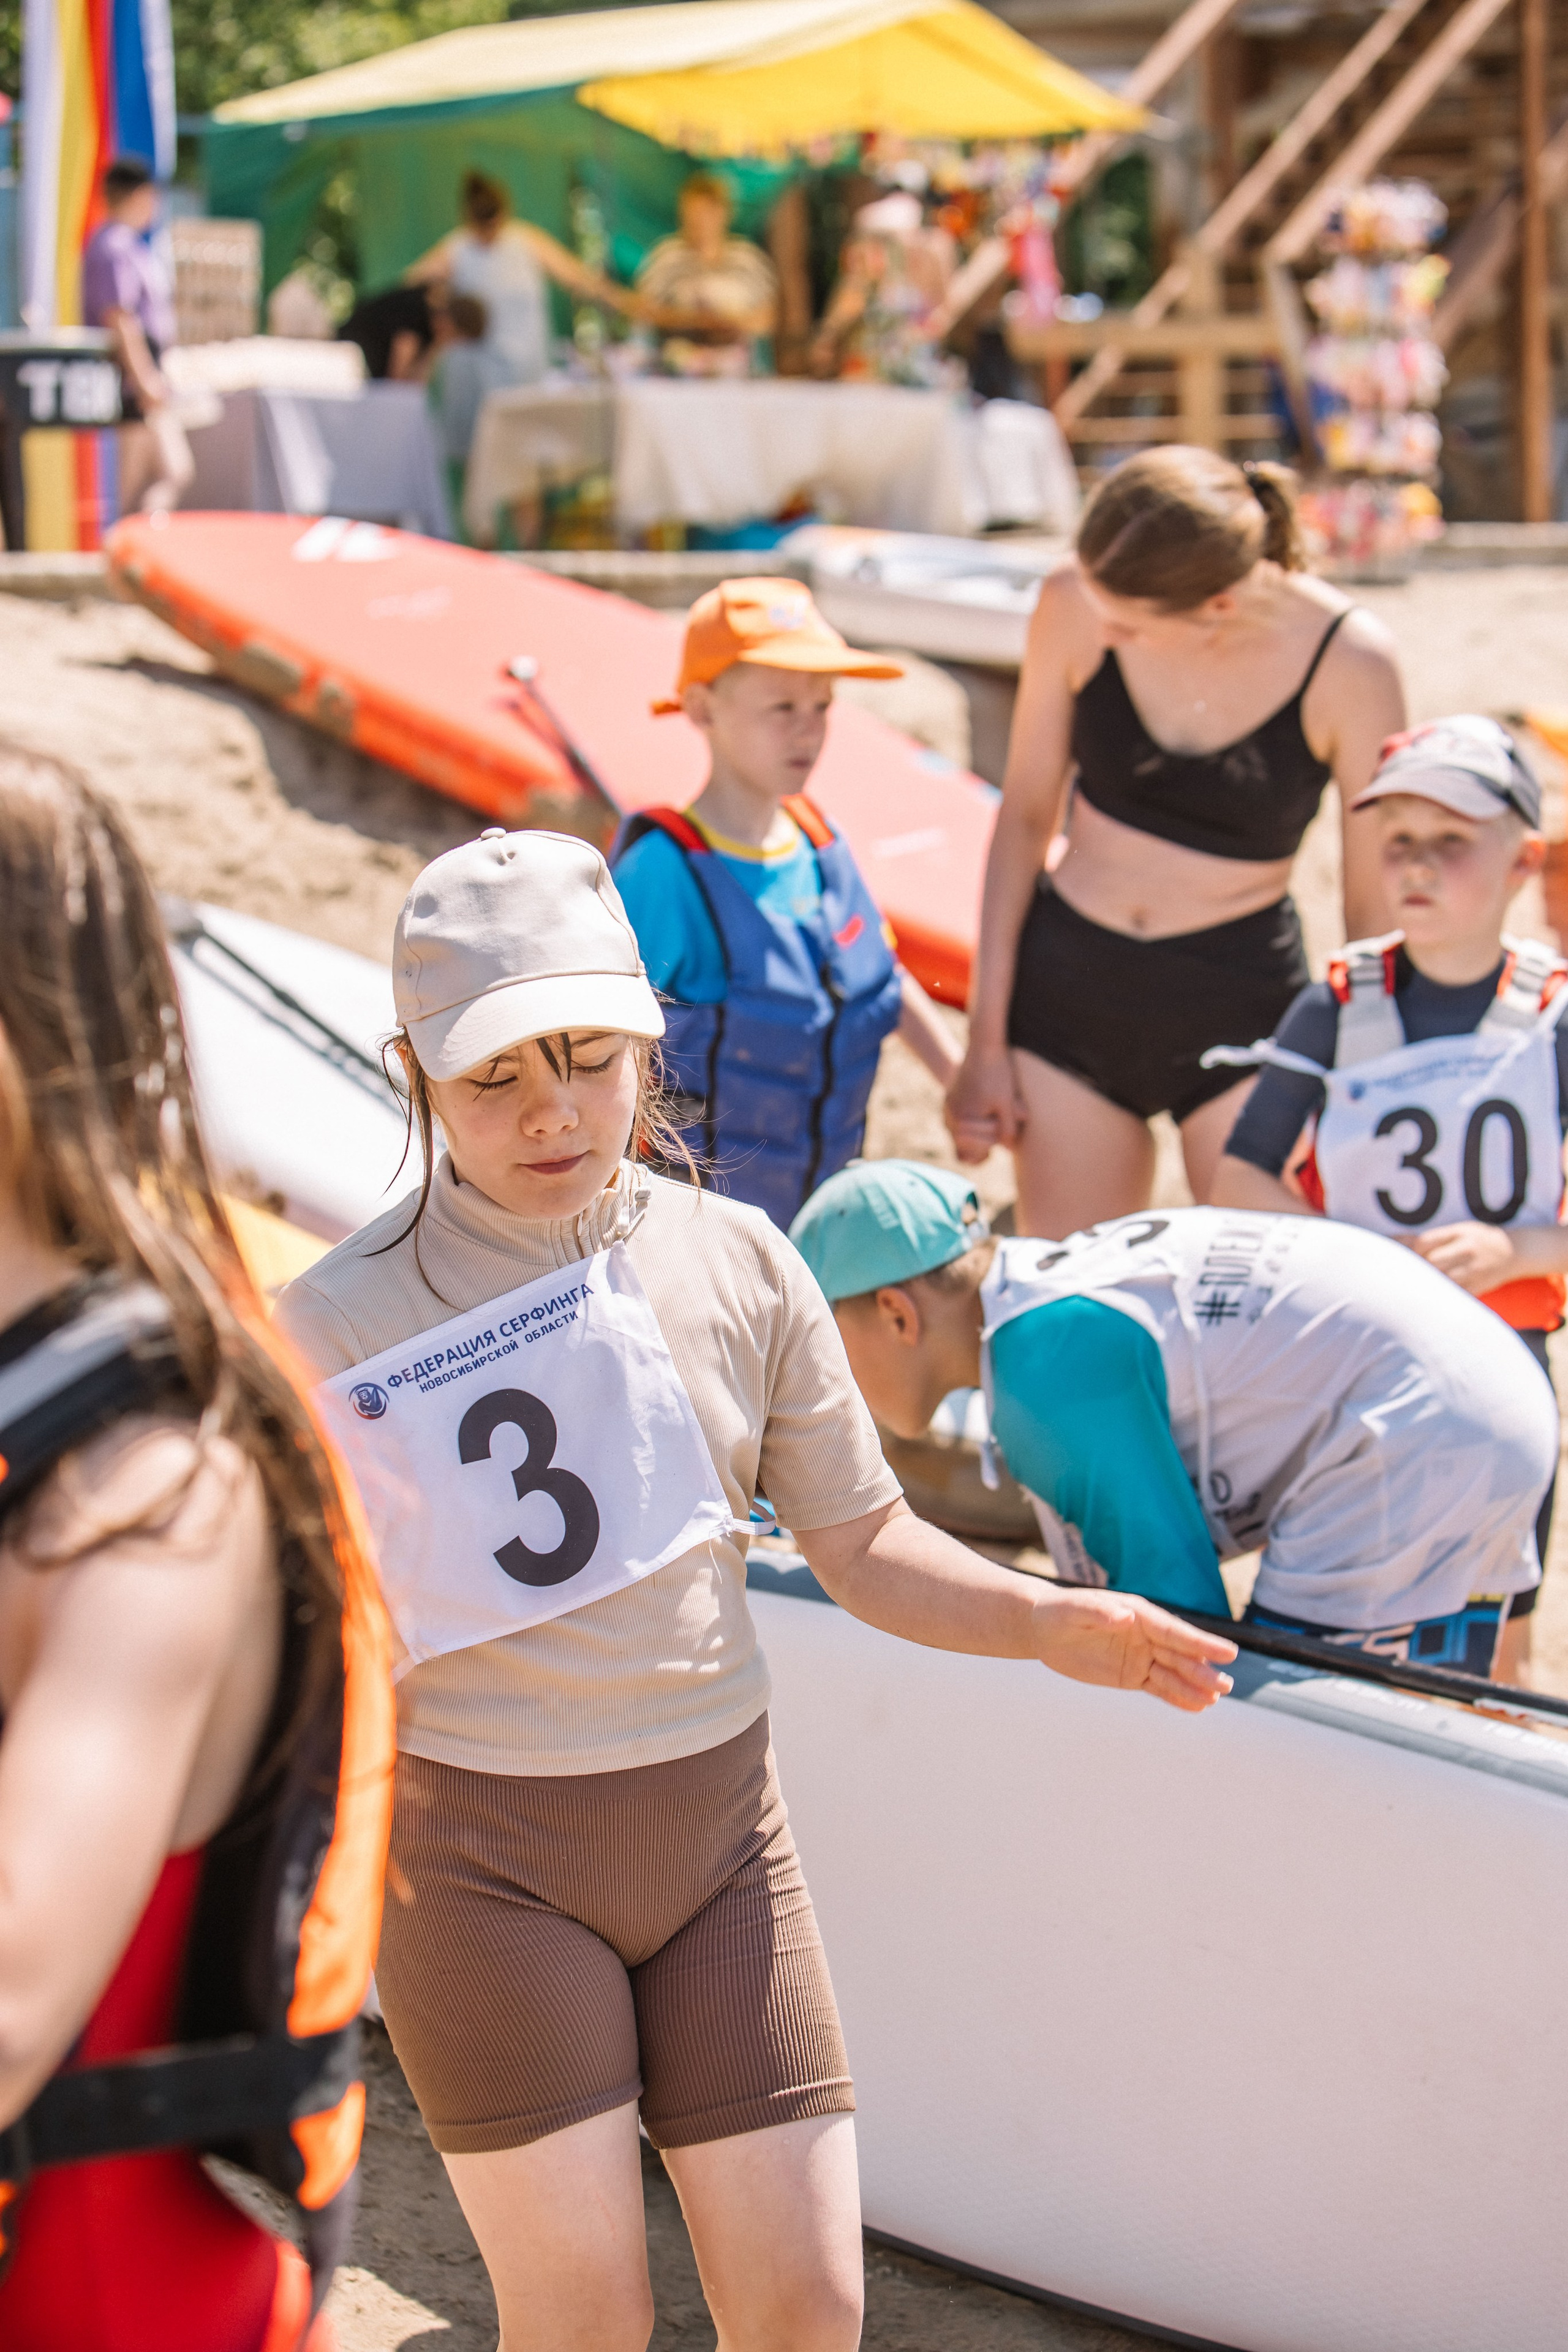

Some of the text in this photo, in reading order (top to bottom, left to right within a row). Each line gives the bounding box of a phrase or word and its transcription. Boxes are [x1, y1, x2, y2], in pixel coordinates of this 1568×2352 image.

[1374, 1099, 1528, 1225] 30
[387, 1283, 595, 1388] ФЕДЕРАЦИЯ СЕРФИНГА
[419, 1310, 579, 1393] НОВОСИБИРСКОЙ ОБЛАСТИ
[458, 1388, 600, 1587] 3
